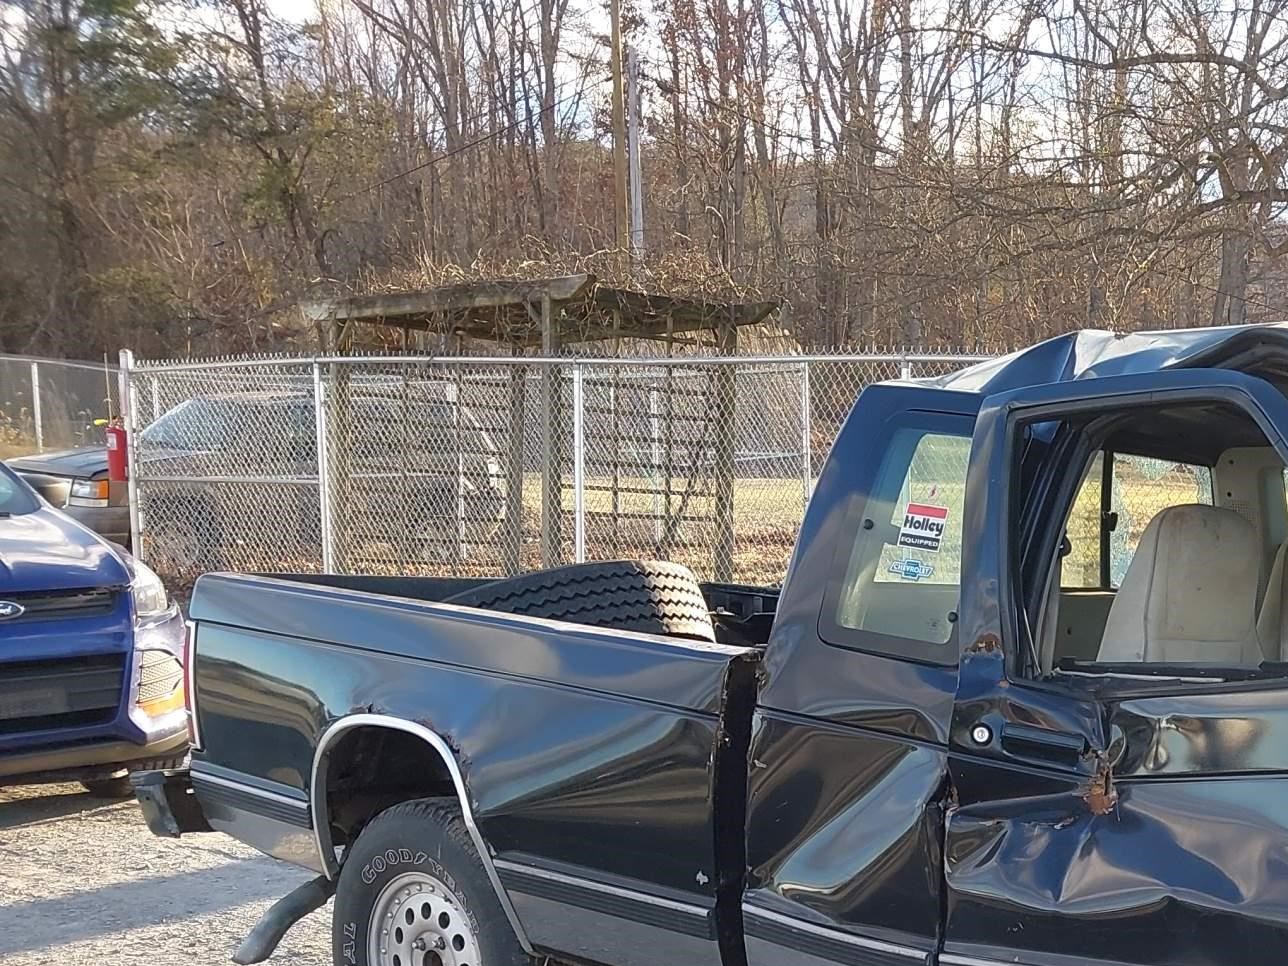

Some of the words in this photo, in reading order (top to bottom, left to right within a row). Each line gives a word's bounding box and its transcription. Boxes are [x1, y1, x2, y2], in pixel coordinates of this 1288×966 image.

[903, 515, 944, 537] Holley
[901, 537, 939, 548] EQUIPPED
[893, 563, 930, 575] CHEVROLET
